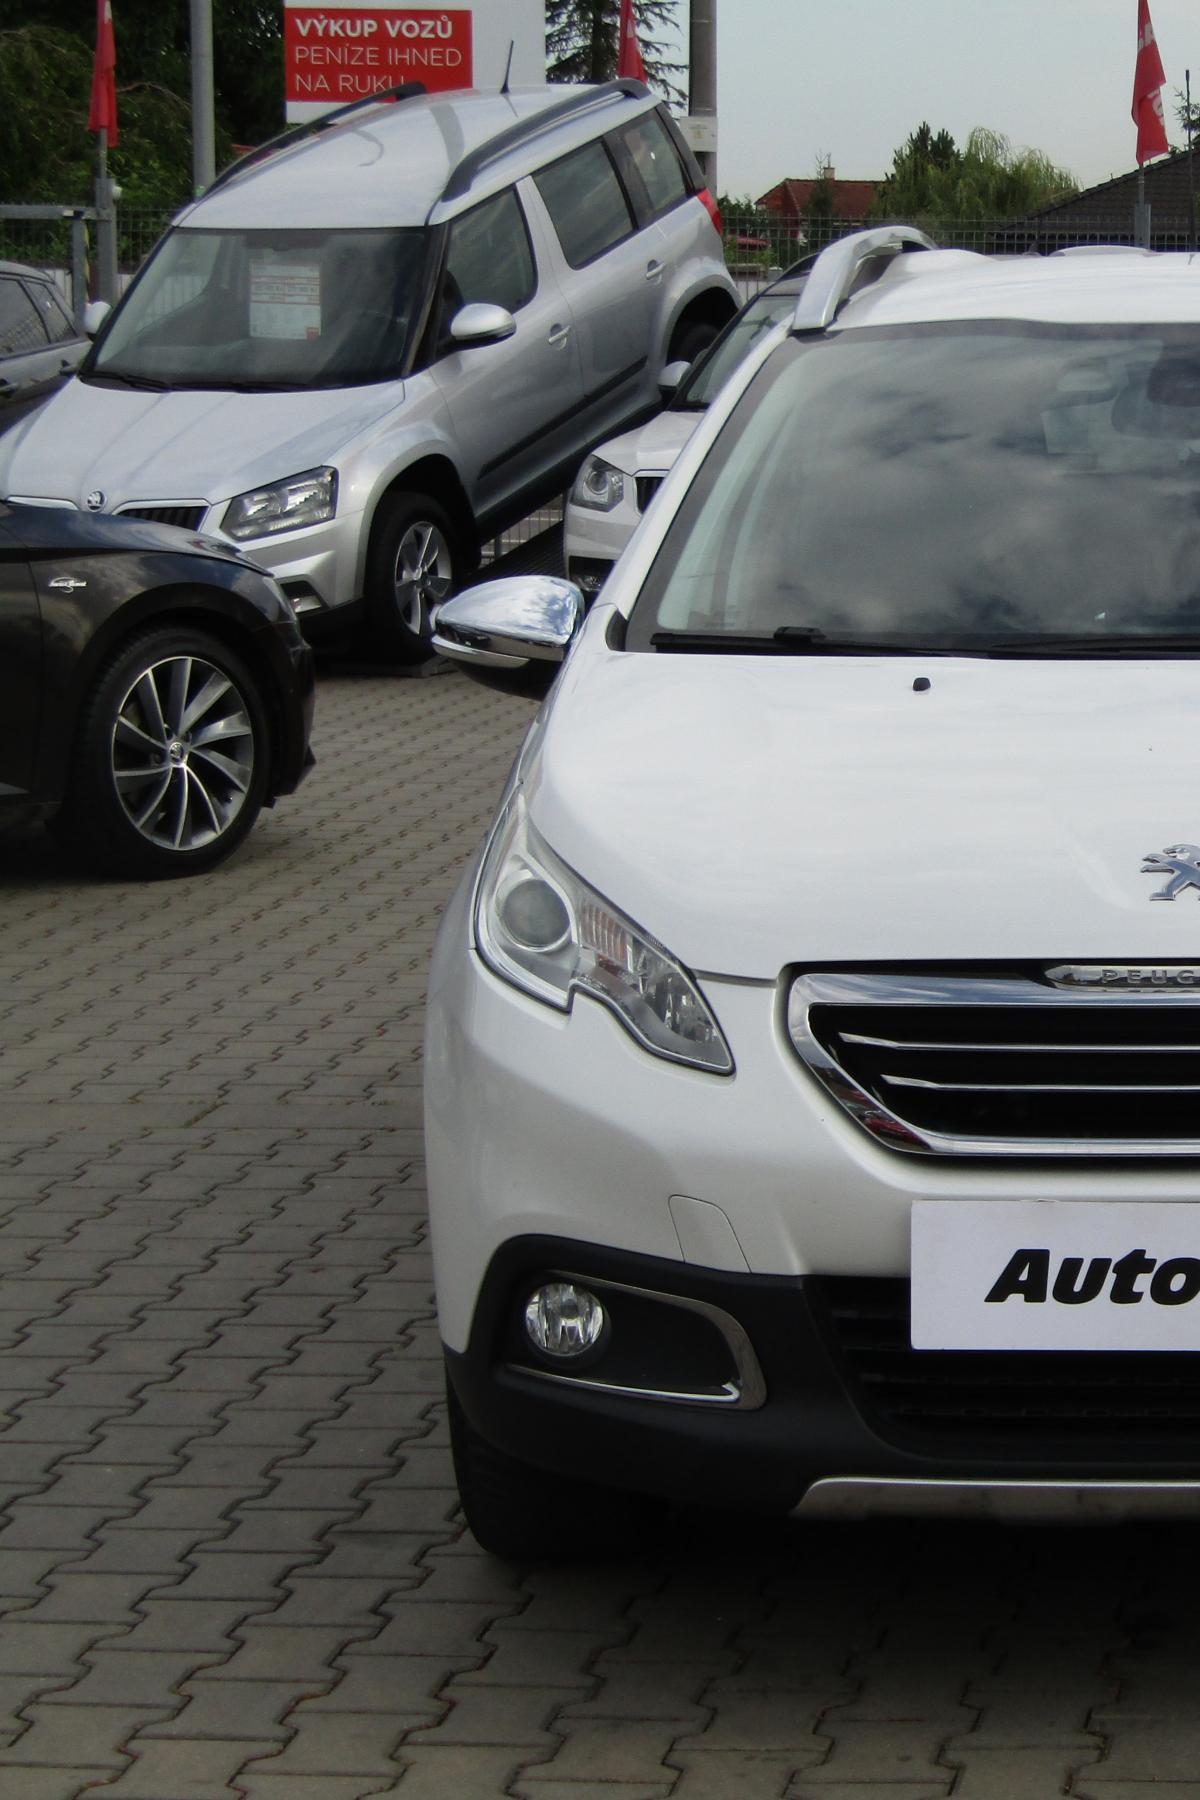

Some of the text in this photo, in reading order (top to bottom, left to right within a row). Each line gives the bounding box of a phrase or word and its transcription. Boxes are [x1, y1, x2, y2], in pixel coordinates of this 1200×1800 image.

[296, 15, 453, 38] VÝKUP VOZŮ
[295, 44, 462, 66] PENÍZE IHNED
[296, 74, 330, 92] NA
